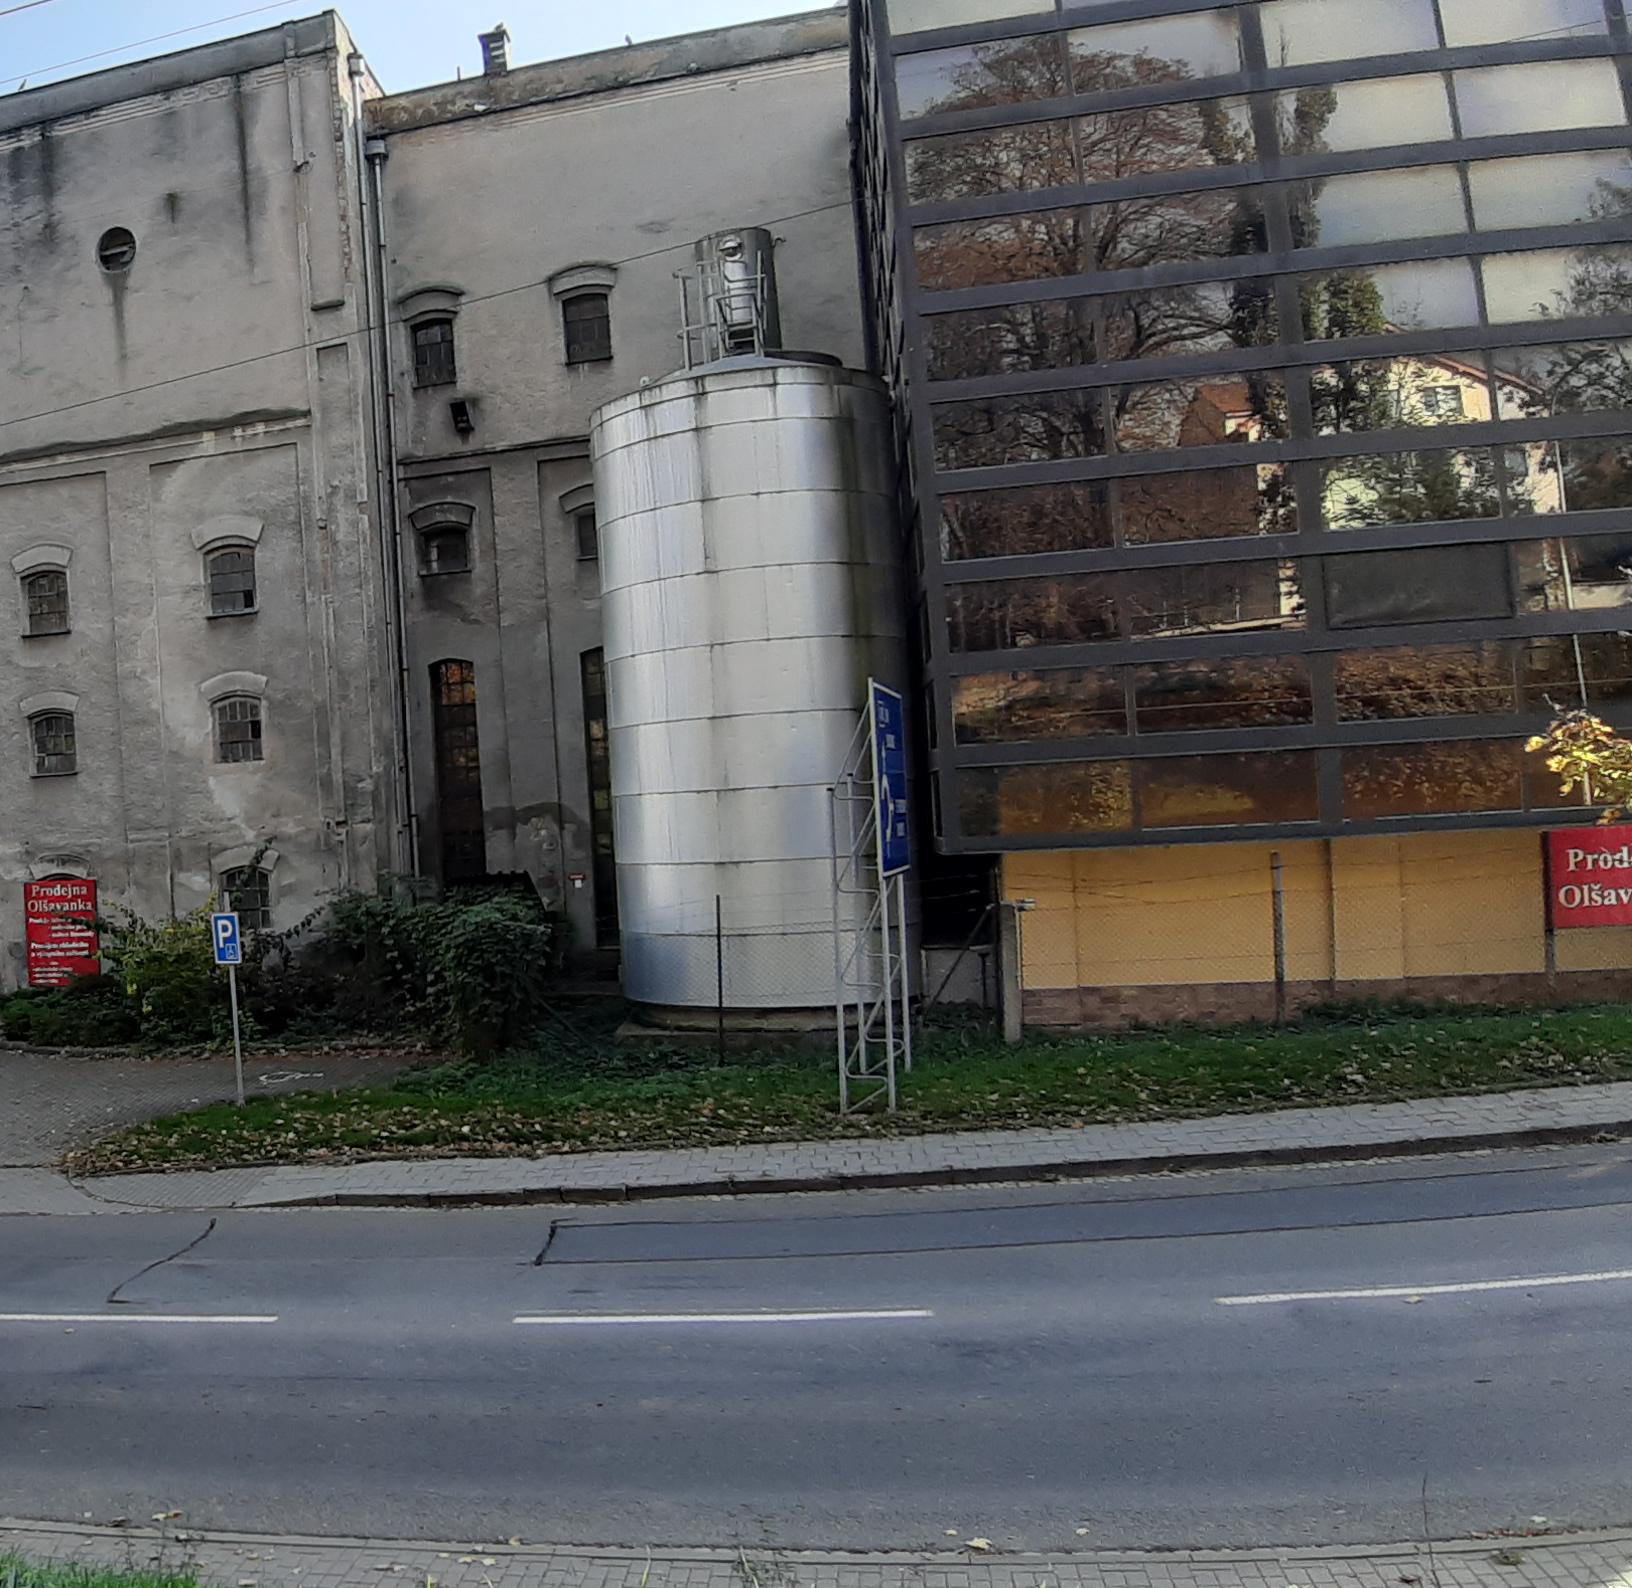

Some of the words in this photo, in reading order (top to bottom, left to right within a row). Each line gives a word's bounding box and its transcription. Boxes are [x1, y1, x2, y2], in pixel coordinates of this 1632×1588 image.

[1565, 846, 1632, 872] Prod
[31, 884, 88, 897] Prodejna
[28, 899, 93, 912] Olšavanka
[217, 919, 232, 948] P
